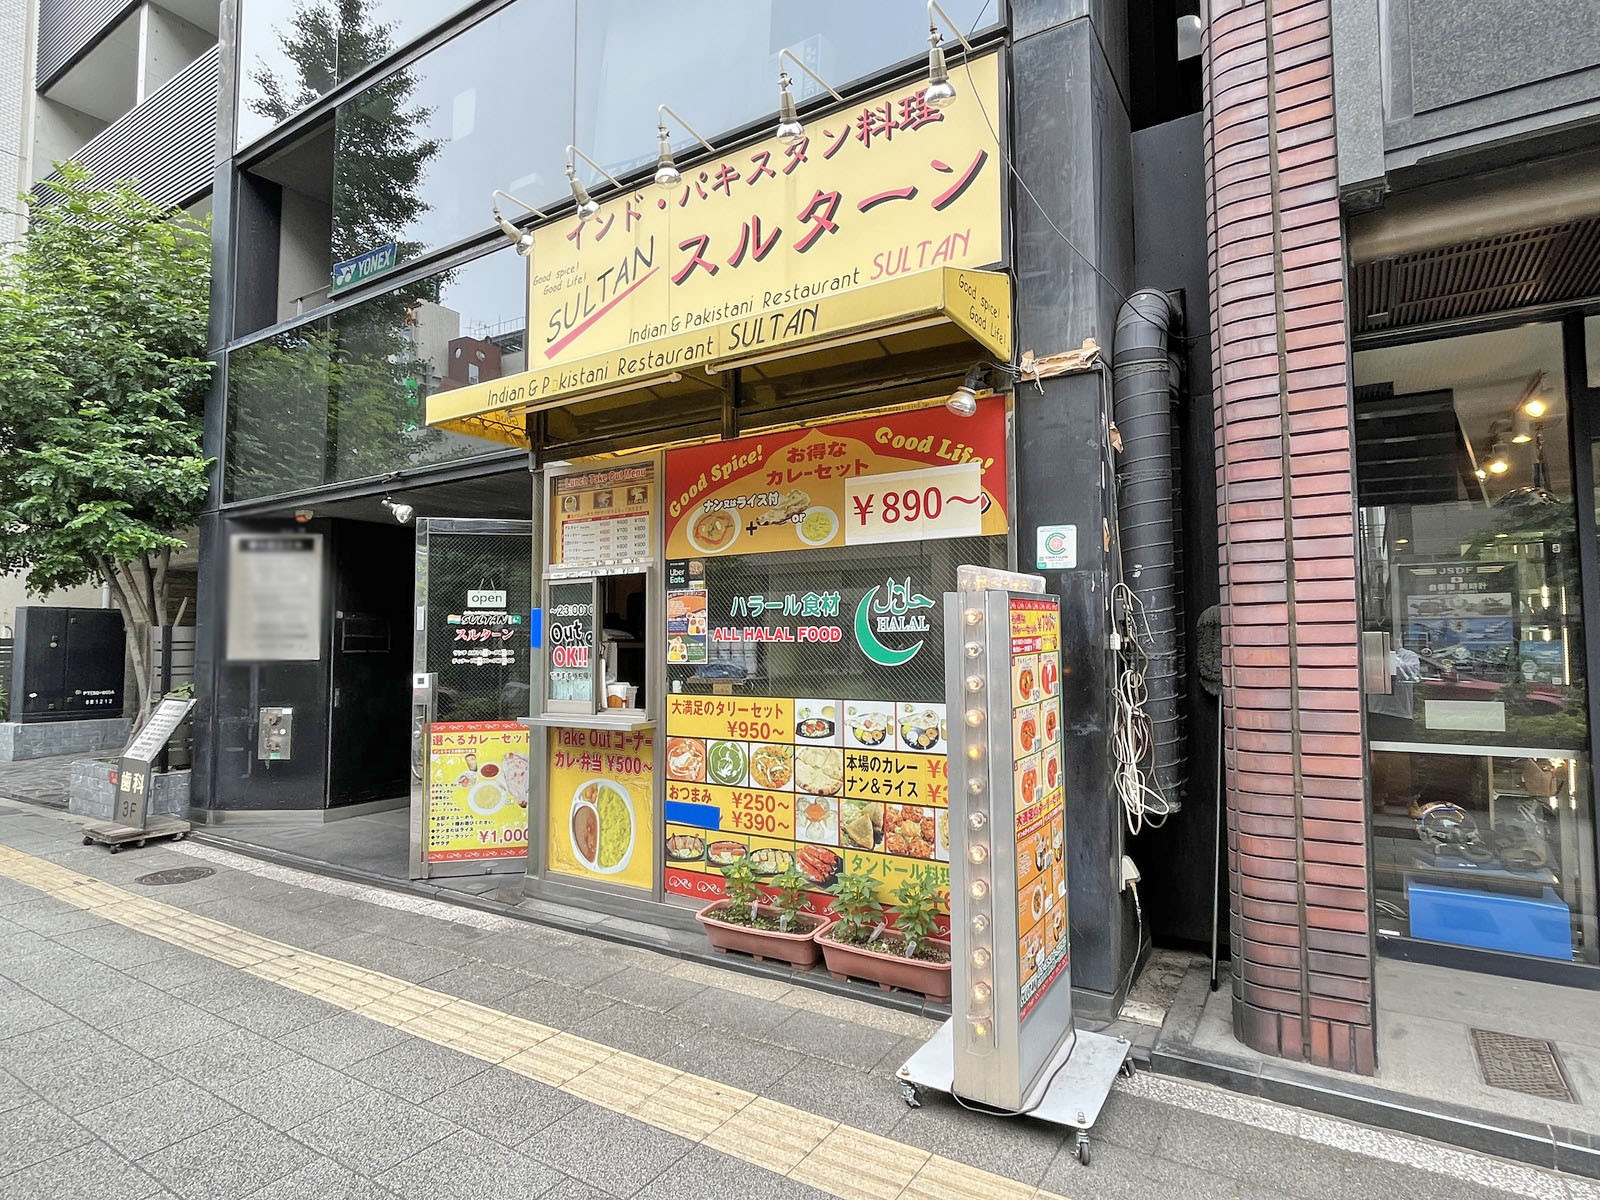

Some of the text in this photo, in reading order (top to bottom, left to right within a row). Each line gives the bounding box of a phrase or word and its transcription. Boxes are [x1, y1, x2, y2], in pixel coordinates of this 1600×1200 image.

[671, 149, 988, 286] スルターン
[358, 247, 392, 278] YONEX
[547, 235, 654, 343] SULTAN
[628, 229, 971, 345] Indian & Pakistani Restaurant SULTAN
[959, 273, 977, 300] Good
[969, 306, 1007, 345] Good Life!
[487, 386, 525, 407] Indian
[529, 379, 539, 397] &
[617, 336, 714, 377] Restaurant
[728, 303, 820, 352] SULTAN
[786, 440, 847, 463] お得な
[875, 426, 994, 476] Good Life!
[668, 445, 764, 518] Good Spice!
[767, 458, 868, 487] カレーセット
[703, 490, 780, 514] ナン又はライス付
[791, 511, 807, 525] or
[670, 569, 685, 577] Uber
[670, 576, 685, 584] Eats
[1439, 566, 1474, 575] JSDF
[472, 594, 503, 605] open
[730, 591, 841, 617] ハラール食材
[454, 629, 515, 641] スルターン
[550, 619, 582, 645] Out
[712, 626, 842, 643] ALL HALAL FOOD
[877, 615, 931, 633] HALAL
[553, 646, 589, 668] OK!!
[671, 700, 785, 720] 大満足のタリーセット
[433, 733, 530, 746] 選べるカレーセット
[557, 727, 654, 751] Take Out コーナー
[555, 751, 602, 772] カレー弁当
[846, 754, 918, 774] 本場のカレー
[120, 771, 145, 795] 歯科
[847, 776, 918, 797] ナン&ライス
[669, 787, 712, 804] おつまみ
[122, 801, 137, 818] 3F
